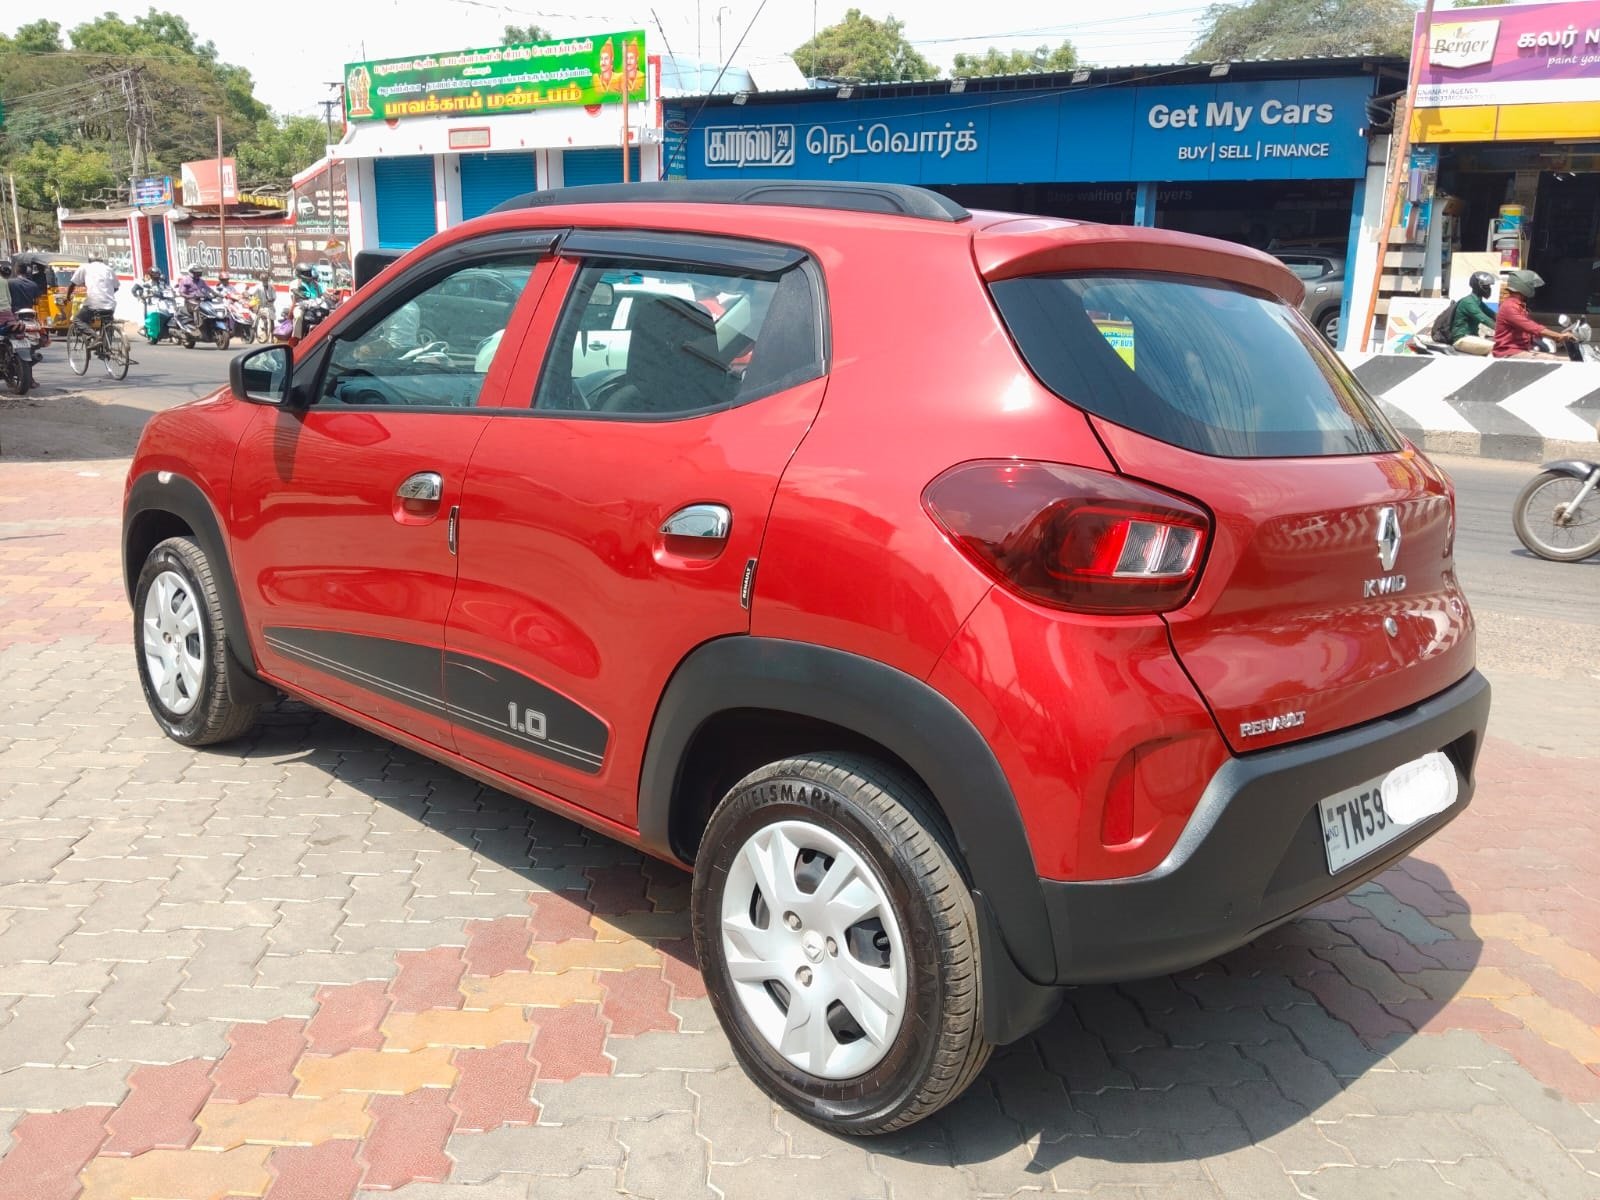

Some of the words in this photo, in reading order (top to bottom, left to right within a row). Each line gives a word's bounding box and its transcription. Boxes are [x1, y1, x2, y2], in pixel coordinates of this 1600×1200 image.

[1434, 38, 1489, 58] Berger
[1516, 24, 1579, 49] கலர்
[385, 91, 483, 115] பாவக்காய்
[487, 82, 582, 108] மண்டபம்
[1148, 104, 1199, 129] Get
[1205, 101, 1253, 132] My
[1260, 99, 1334, 125] Cars
[776, 130, 789, 147] 24
[806, 122, 978, 164] நெட்வொர்க்
[1178, 146, 1208, 160] BUY
[1218, 145, 1253, 158] SELL
[1263, 143, 1330, 158] FINANCE
[1363, 574, 1407, 598] KWID
[507, 701, 547, 740] 1.0
[1240, 710, 1306, 738] RENAULT
[1335, 786, 1394, 850] TN59
